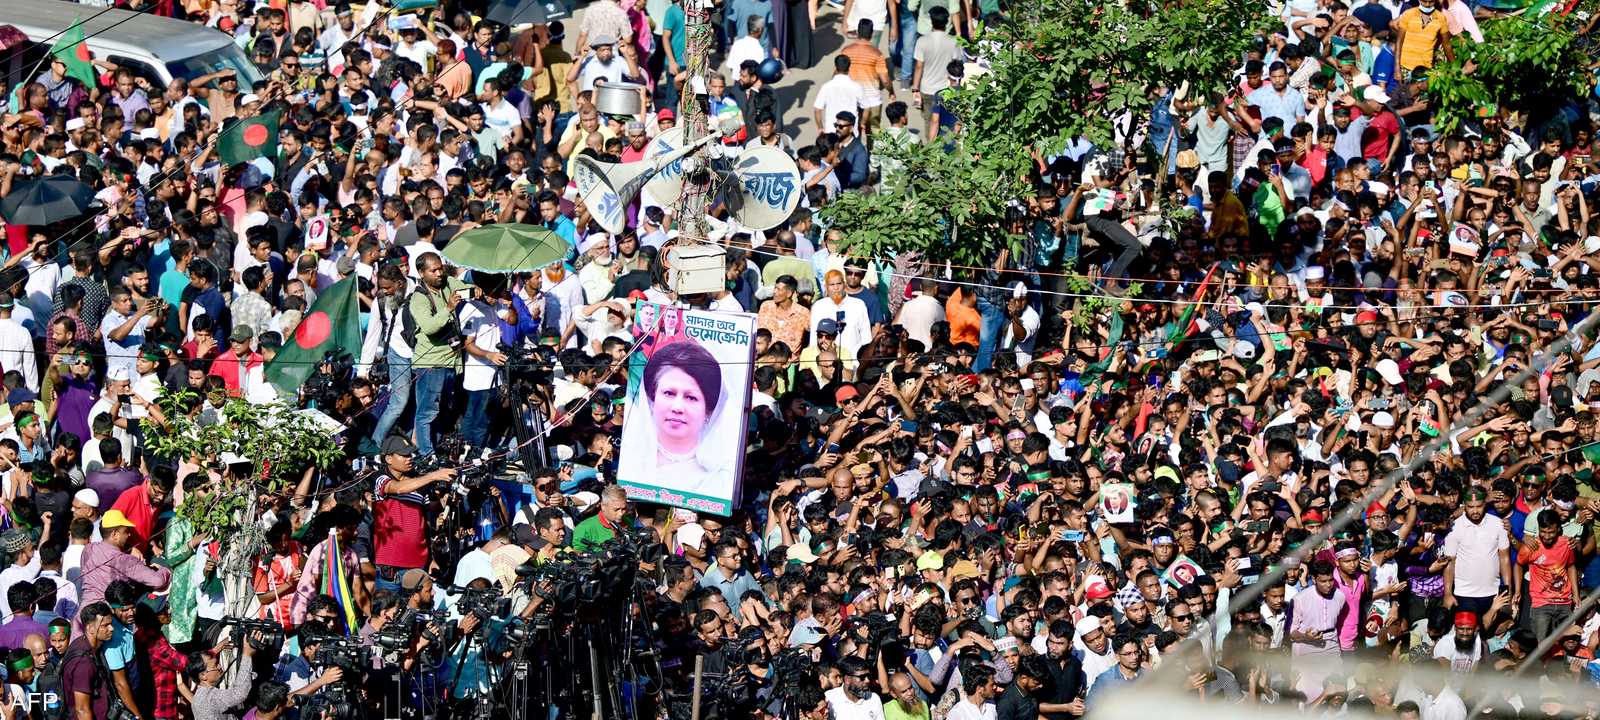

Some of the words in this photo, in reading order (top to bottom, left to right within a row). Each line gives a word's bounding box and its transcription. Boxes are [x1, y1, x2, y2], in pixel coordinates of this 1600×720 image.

[686, 315, 715, 328] মাদার
[716, 320, 736, 331] অব
[684, 326, 749, 346] ডেমোক্রেসি
